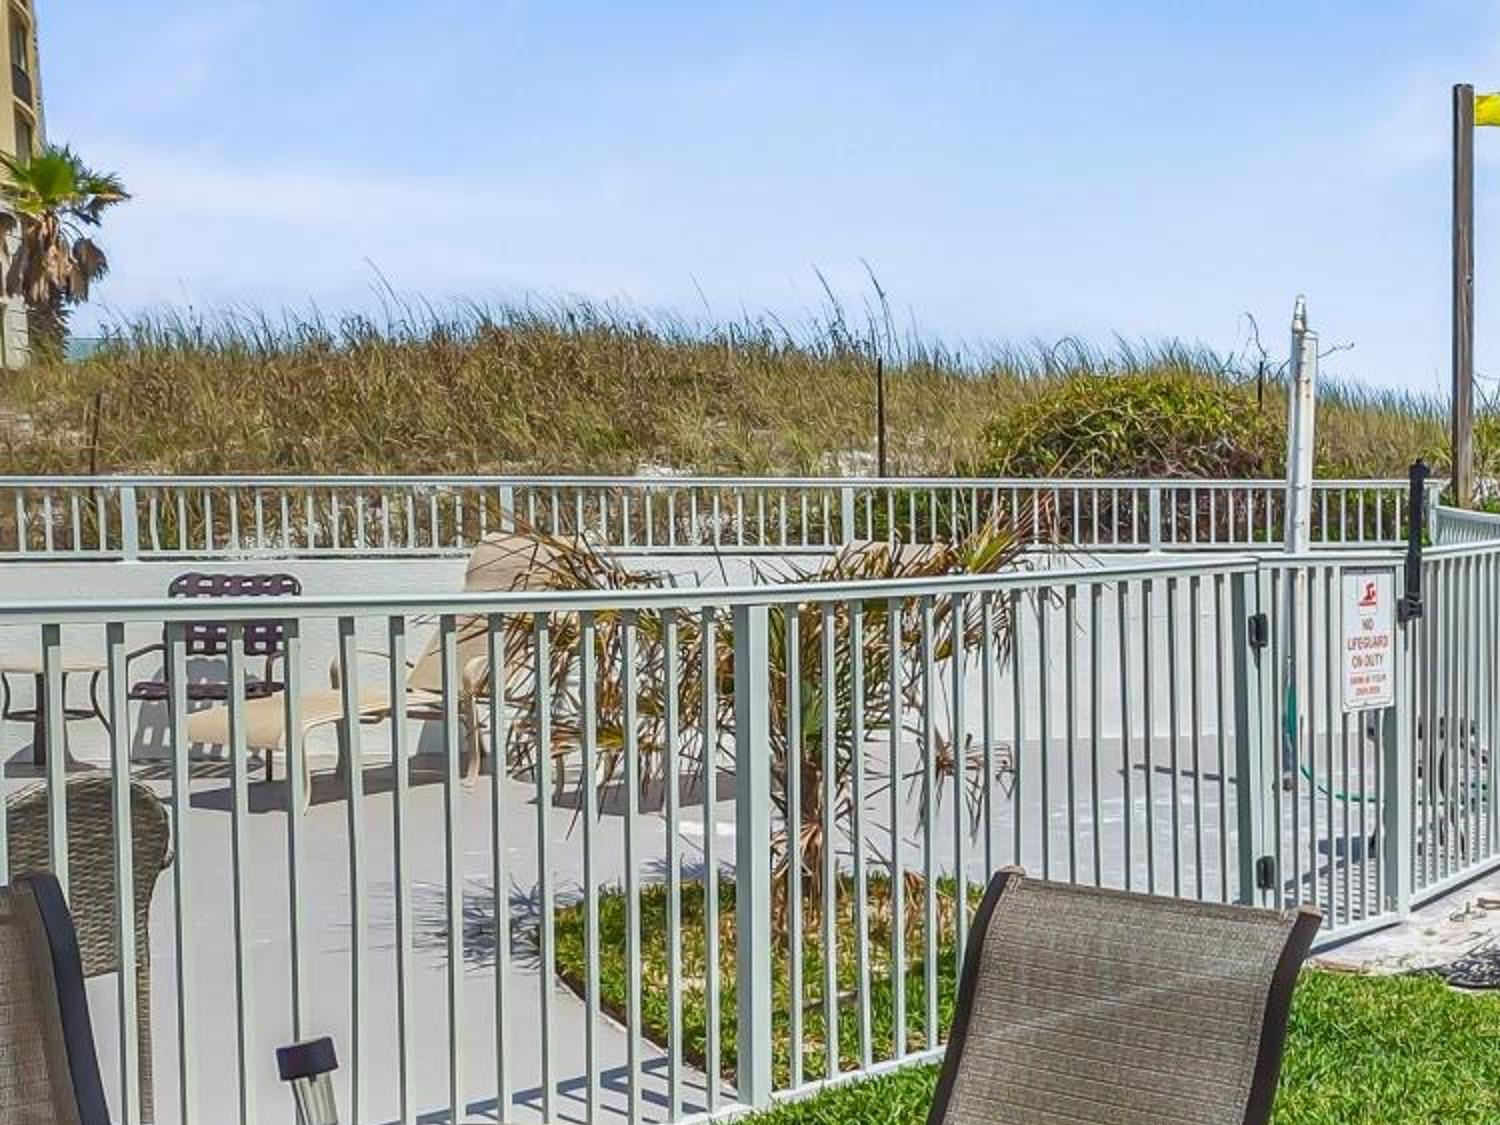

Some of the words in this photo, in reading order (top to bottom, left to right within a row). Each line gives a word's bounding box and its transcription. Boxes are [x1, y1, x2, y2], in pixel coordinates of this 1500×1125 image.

[1361, 618, 1374, 631] NO
[1347, 635, 1388, 651] LIFEGUARD
[1351, 655, 1362, 668] ON
[1365, 654, 1383, 667] DUTY
